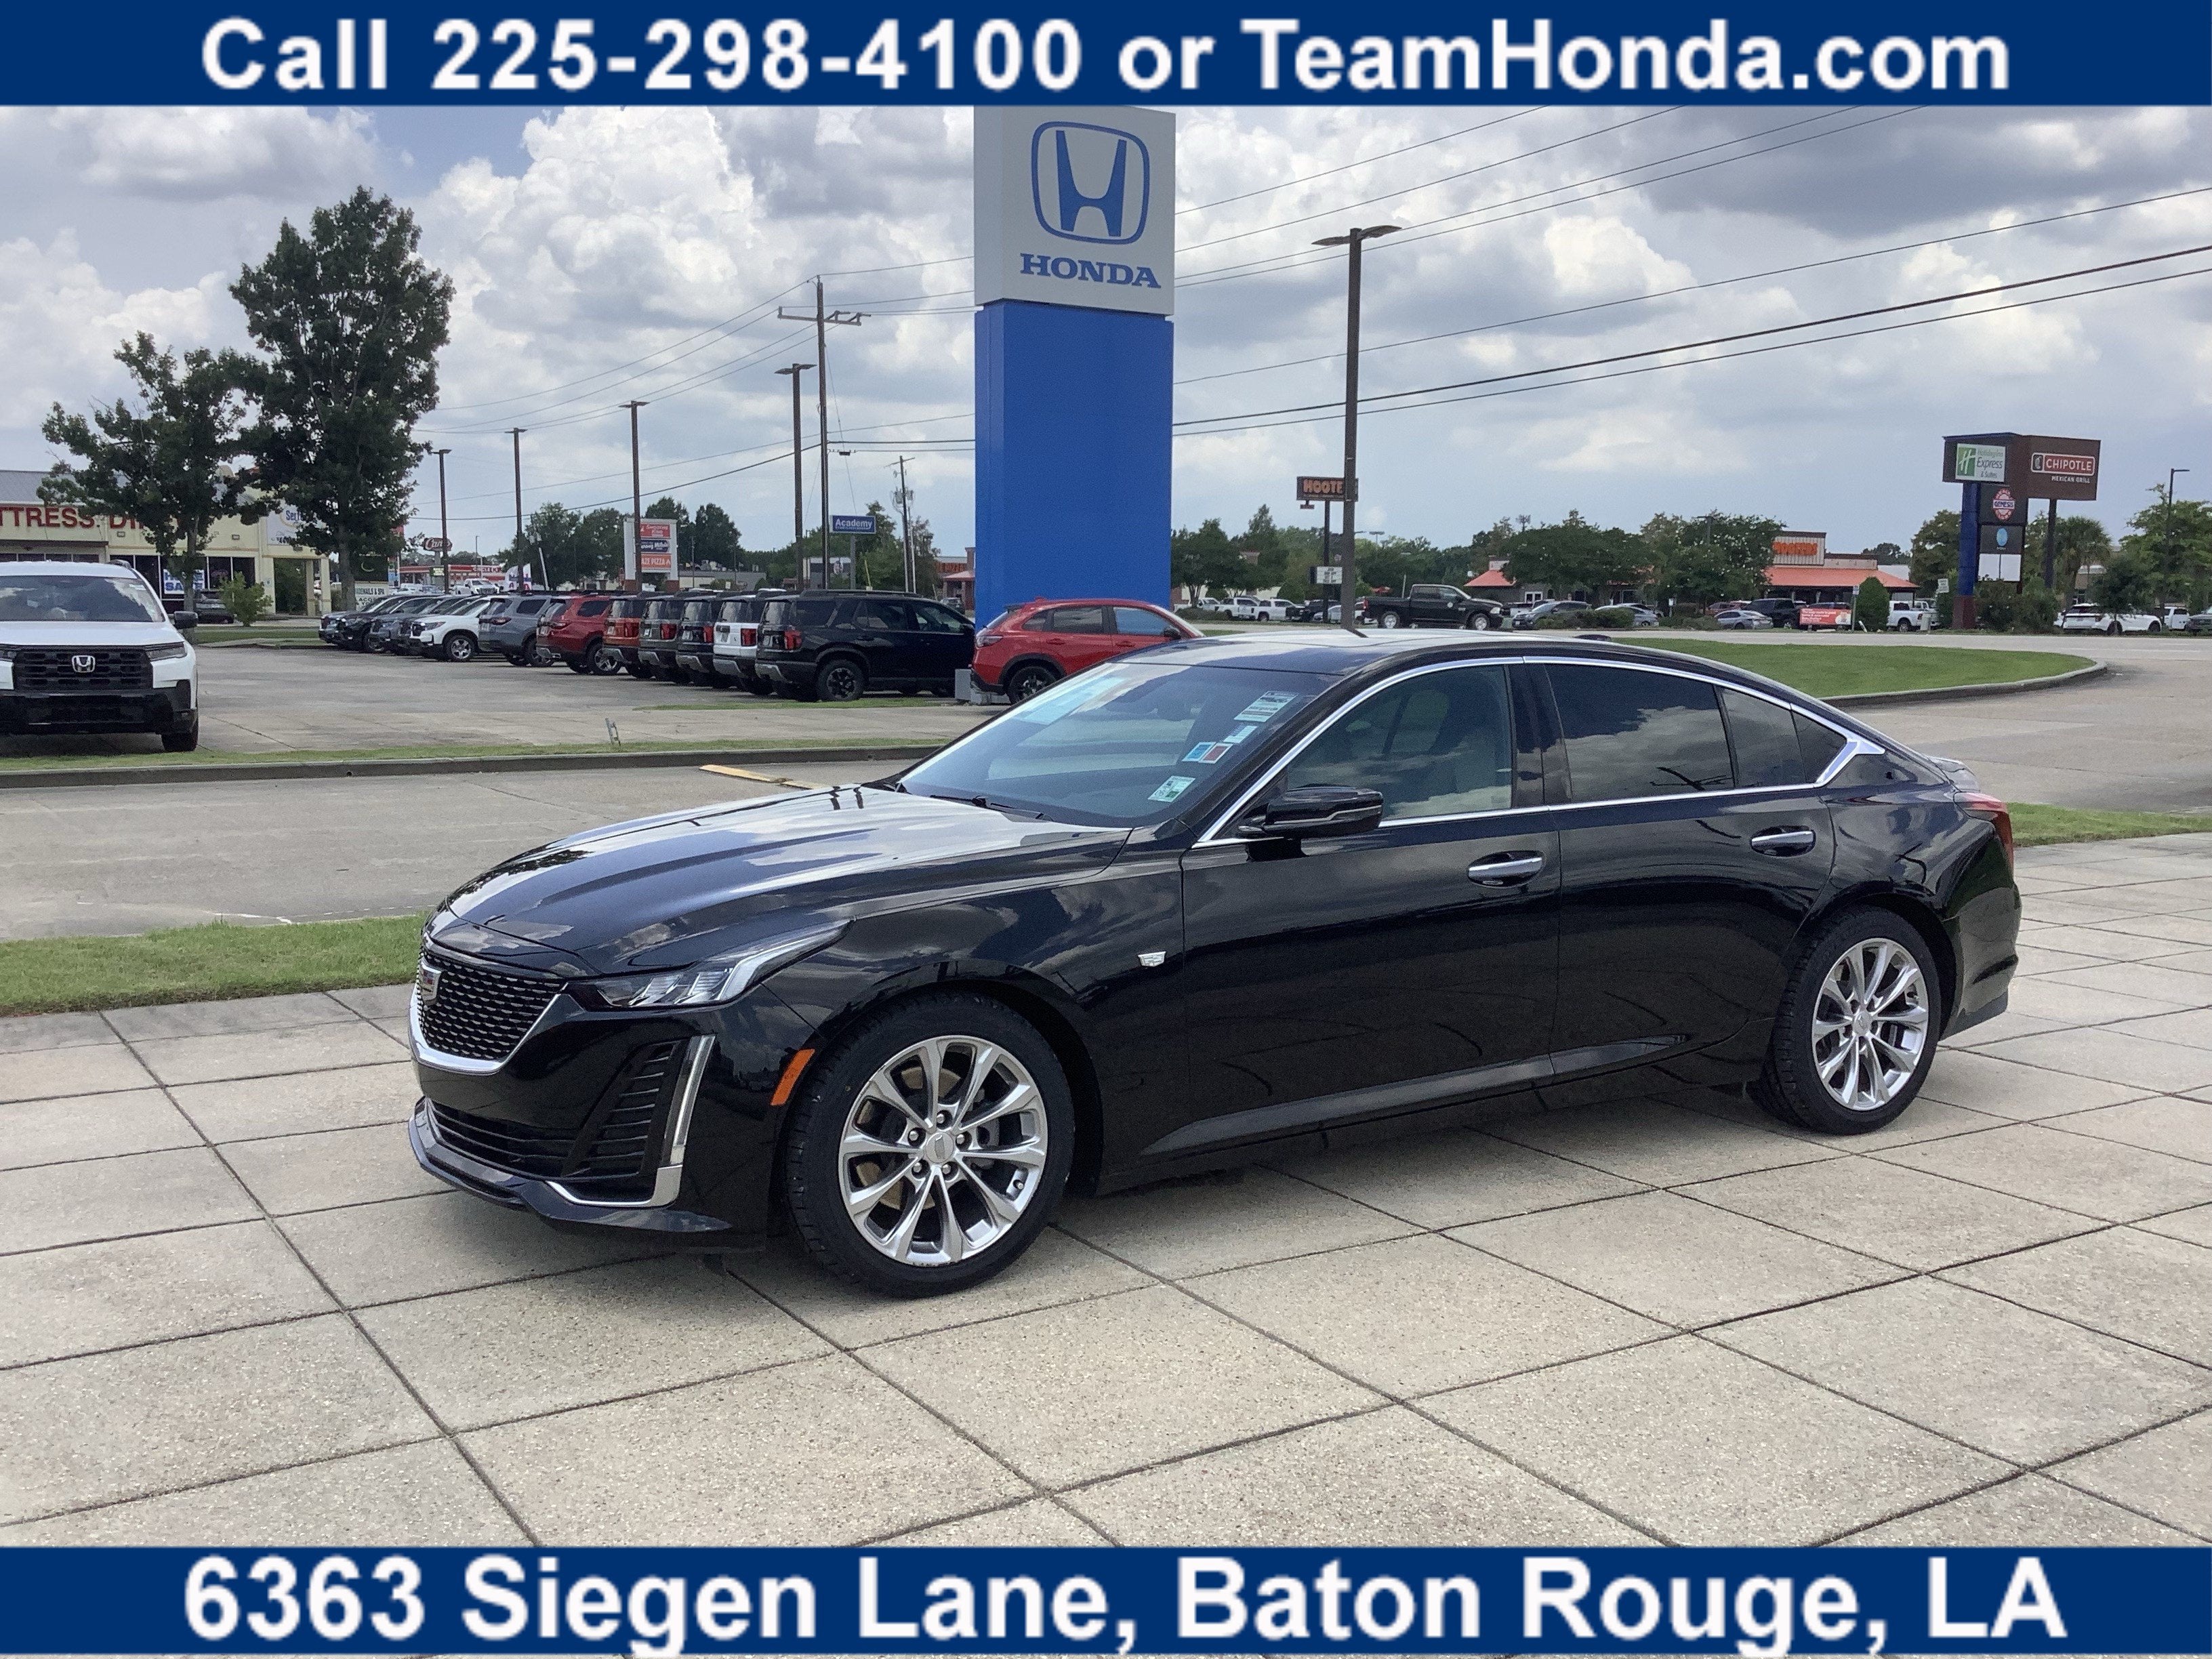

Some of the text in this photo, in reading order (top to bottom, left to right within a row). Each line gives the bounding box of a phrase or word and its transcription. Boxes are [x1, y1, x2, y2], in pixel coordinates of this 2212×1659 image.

[1020, 253, 1161, 288] HONDA
[1976, 457, 2003, 470] Express
[2046, 458, 2092, 472] CHIPOTLE
[1303, 478, 1345, 494] HOOTE
[835, 518, 872, 529] Academy
